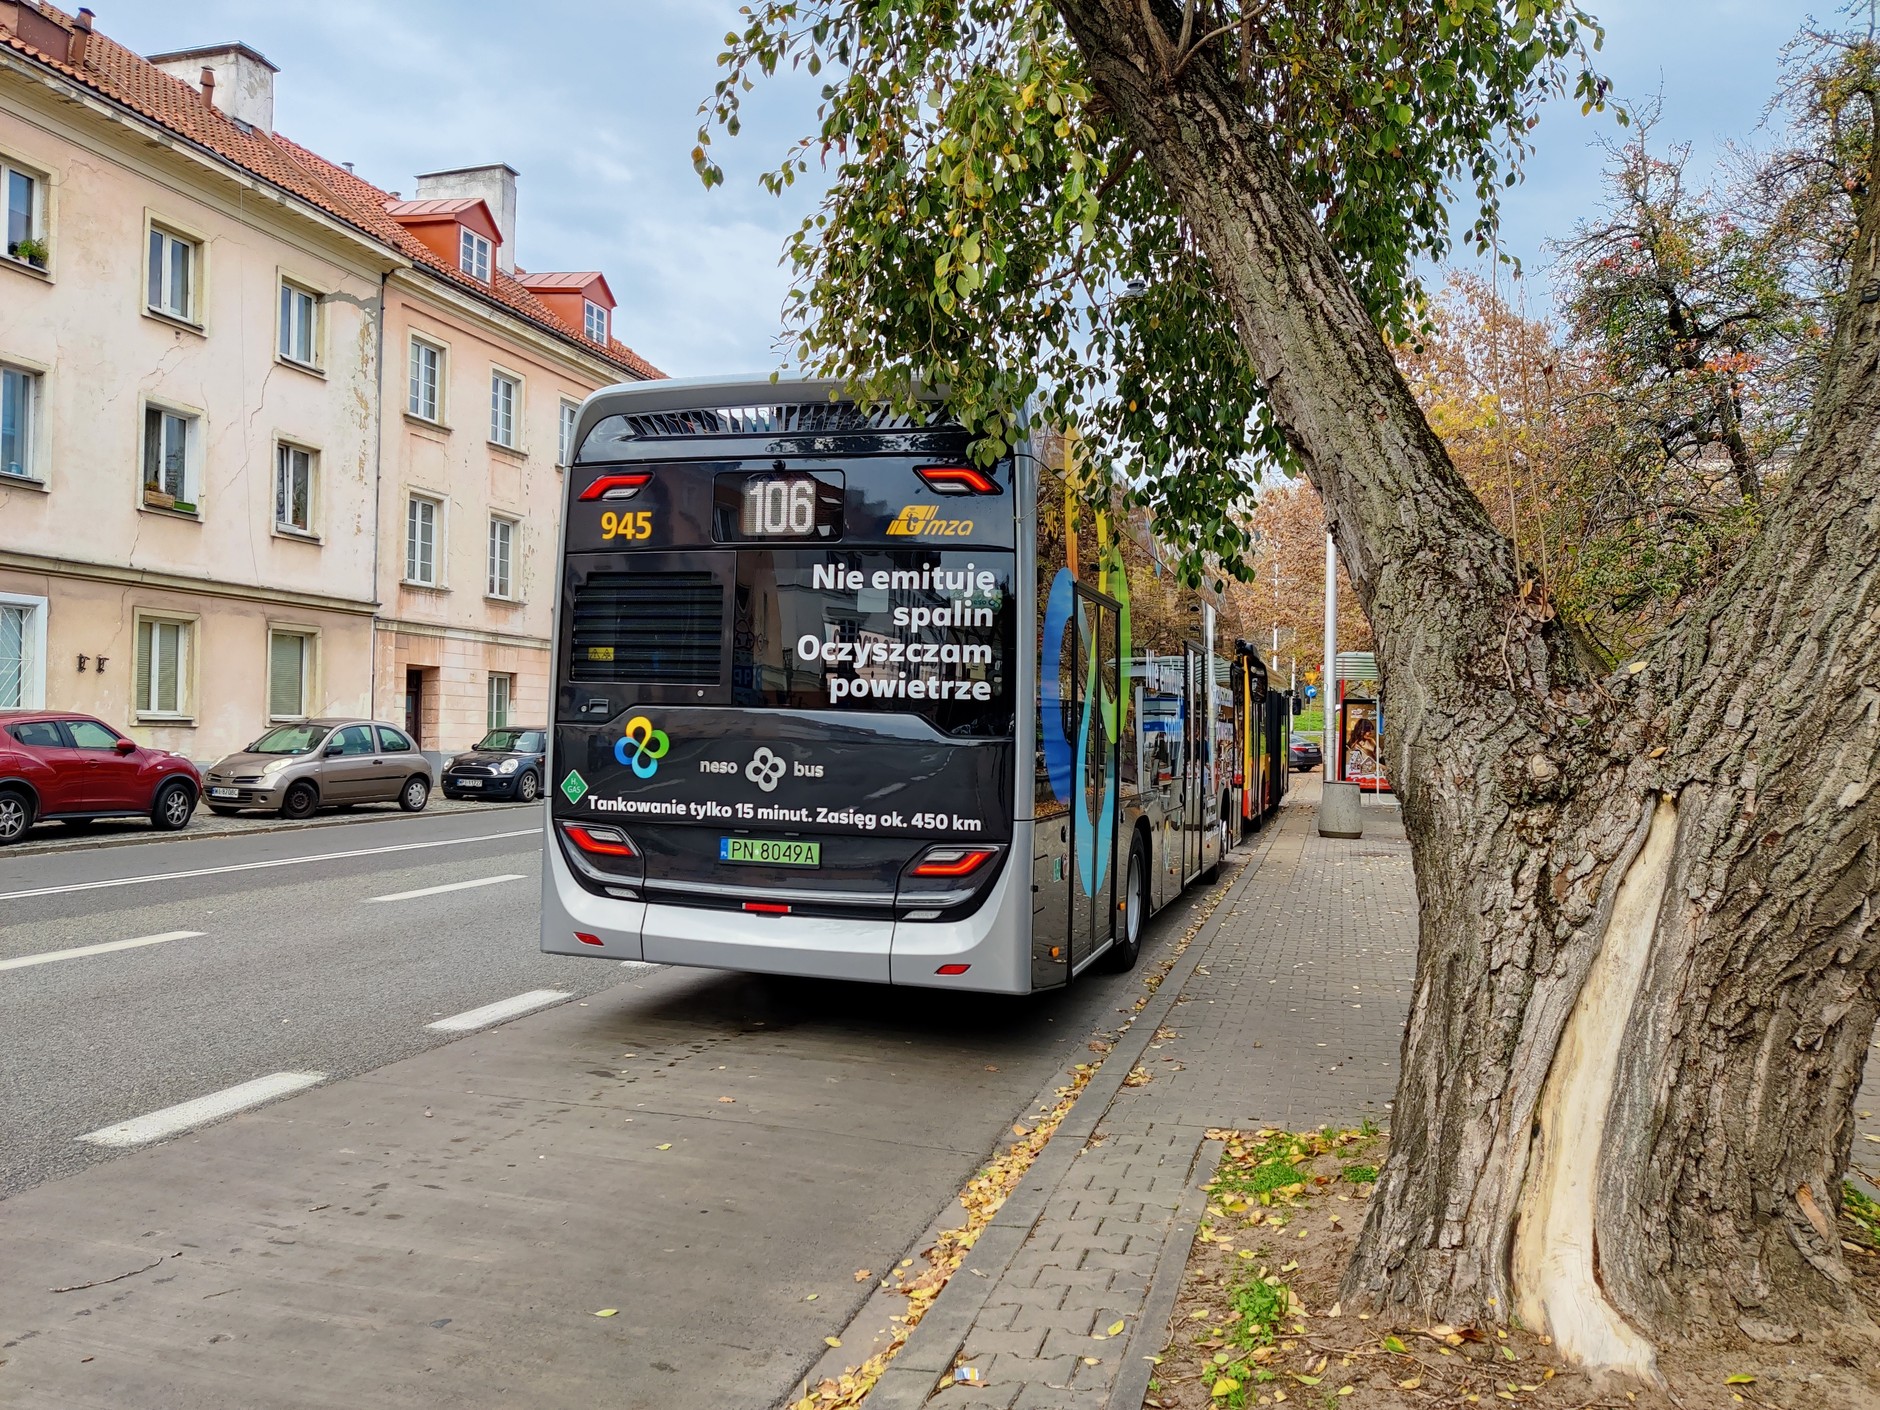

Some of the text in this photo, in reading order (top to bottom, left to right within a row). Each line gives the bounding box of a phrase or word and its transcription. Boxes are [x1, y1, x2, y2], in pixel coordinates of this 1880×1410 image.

[749, 480, 813, 533] 106
[601, 511, 653, 540] 945
[923, 519, 974, 536] mza
[812, 562, 995, 598] Nie emituję
[893, 599, 993, 633] spalin
[797, 635, 992, 669] Oczyszczam
[830, 671, 991, 704] powietrze
[699, 760, 824, 778] neso bus
[567, 785, 581, 794] GAS
[587, 795, 982, 831] Tankowanie tylko 15 minut. Zasięg ok. 450 km
[731, 841, 815, 863] PN 8049A
